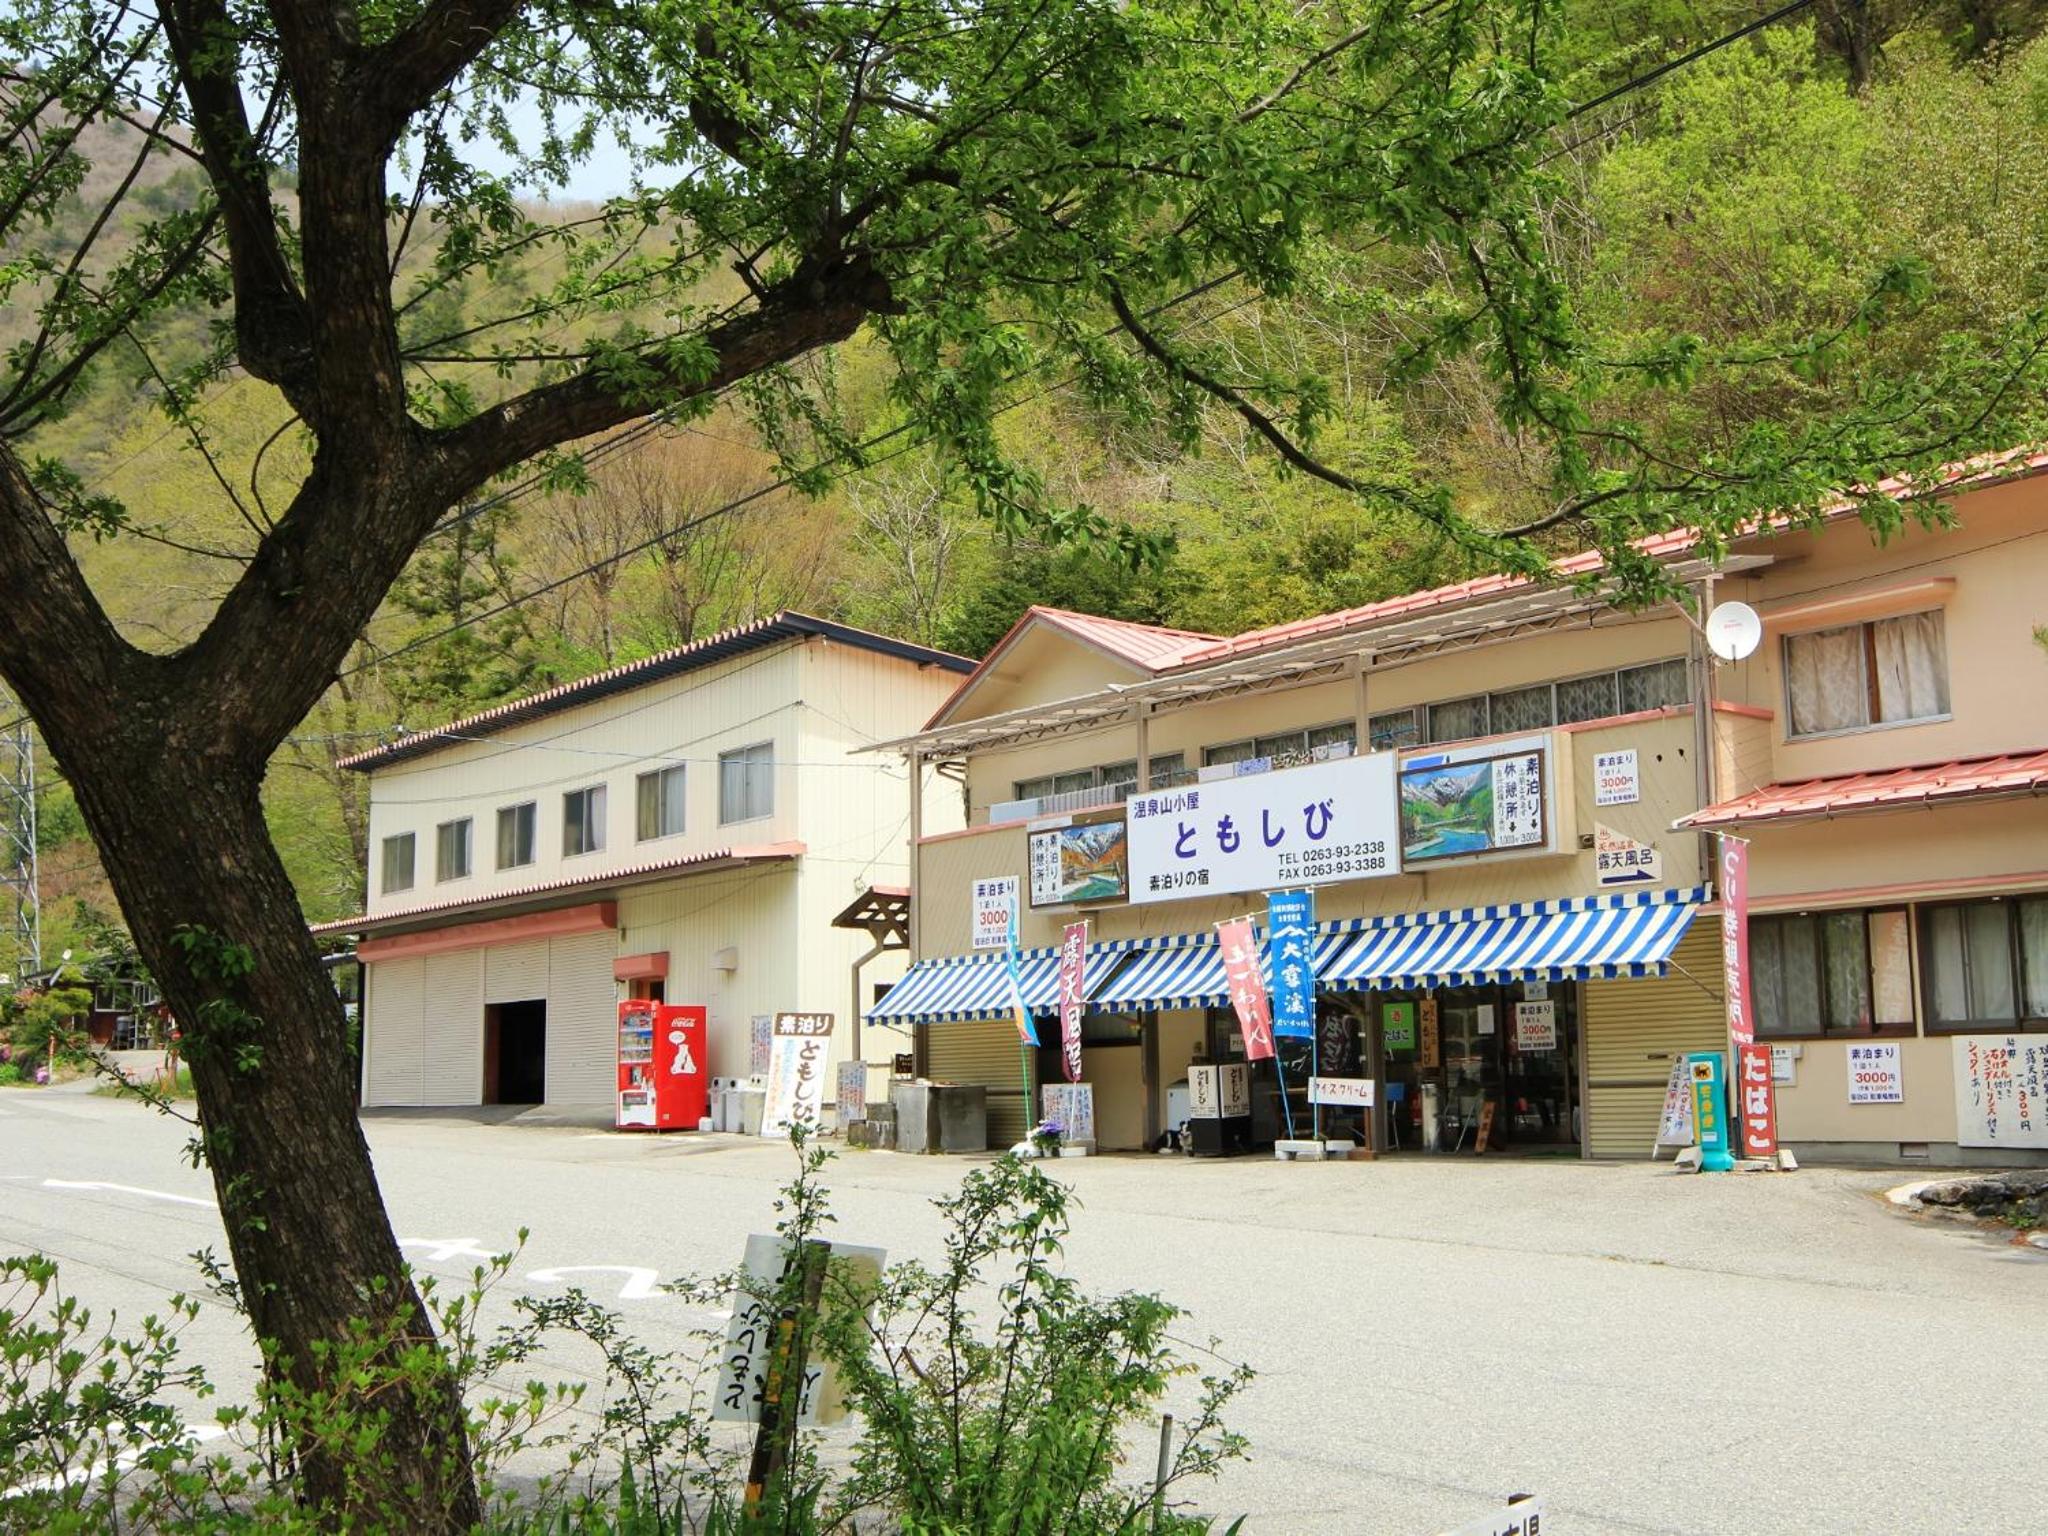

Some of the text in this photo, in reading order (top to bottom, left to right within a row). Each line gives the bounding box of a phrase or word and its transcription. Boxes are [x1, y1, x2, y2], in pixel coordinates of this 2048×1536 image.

[1526, 757, 1540, 817] 素泊り
[1134, 791, 1199, 819] 温泉山小屋
[1174, 798, 1334, 859] ともしび
[1279, 841, 1385, 865] TEL 0263-93-2338
[1598, 848, 1653, 870] 露天風呂
[1149, 868, 1210, 892] 素泊りの宿
[1279, 857, 1386, 881] FAX 0263-93-3388
[780, 1015, 829, 1034] 素泊り
[1851, 1048, 1894, 1059] 素泊まり
[792, 1040, 820, 1120] ともしび
[1855, 1072, 1896, 1083] 3000円
